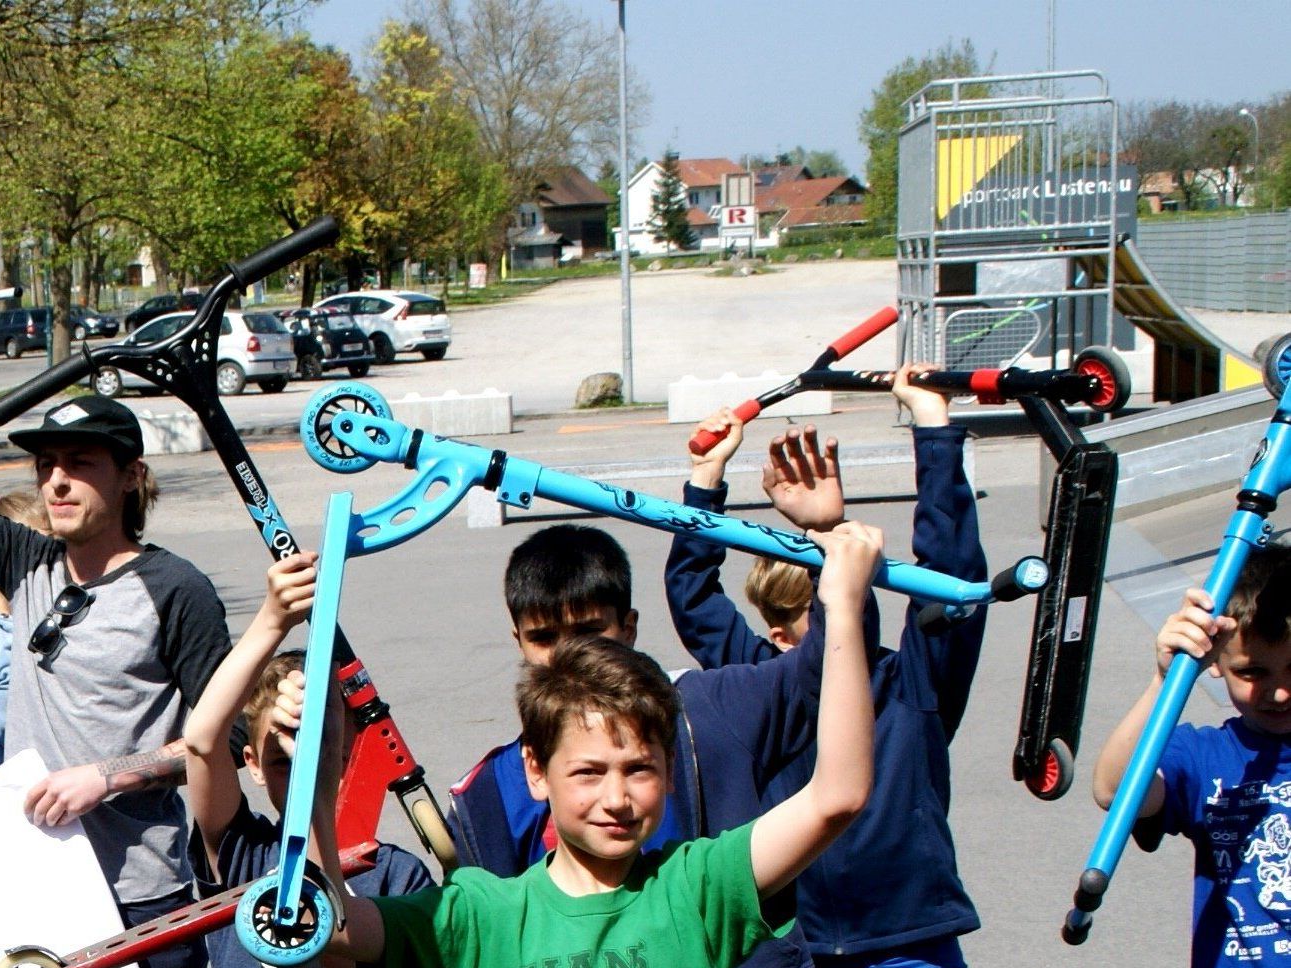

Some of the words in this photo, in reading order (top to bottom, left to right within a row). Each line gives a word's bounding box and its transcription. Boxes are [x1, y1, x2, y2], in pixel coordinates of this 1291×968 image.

[960, 186, 1040, 207] portpark
[1044, 178, 1132, 198] Lustenau
[728, 208, 747, 225] R
